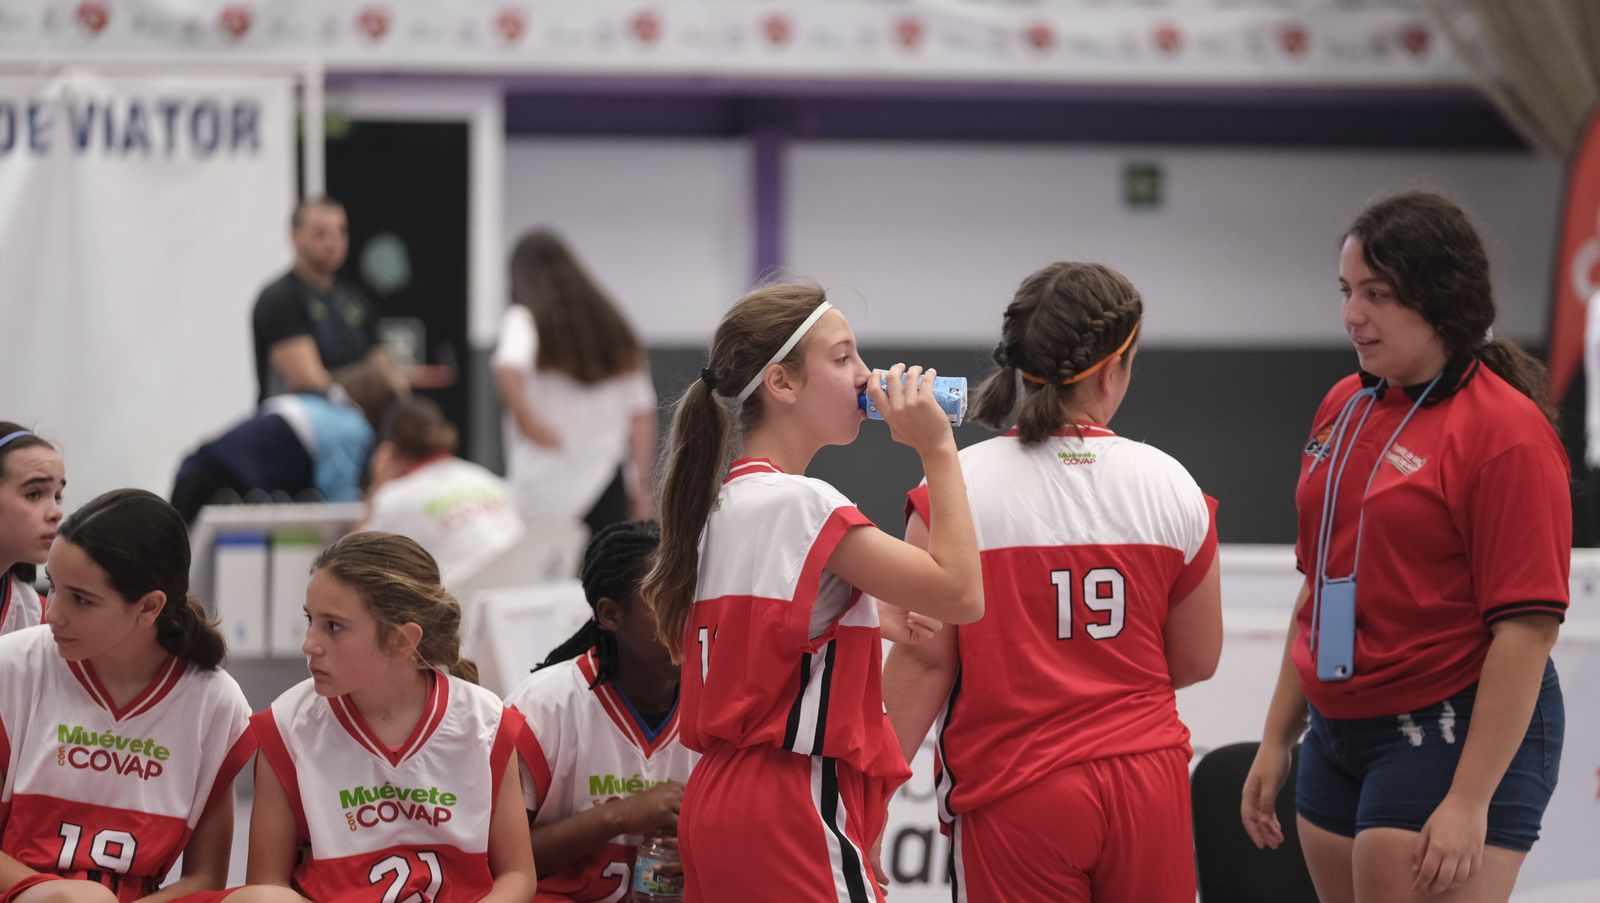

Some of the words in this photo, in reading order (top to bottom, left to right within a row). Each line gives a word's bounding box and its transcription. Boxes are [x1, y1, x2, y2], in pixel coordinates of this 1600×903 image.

[68, 98, 262, 156] VIATOR
[1063, 457, 1096, 466] COVAP
[1050, 567, 1126, 640] 19
[698, 624, 719, 688] 1
[57, 724, 170, 761] Muévete
[68, 746, 163, 780] COVAP
[339, 781, 457, 809] Muévete
[356, 801, 452, 827] COVAP
[56, 821, 137, 874] 19
[368, 850, 443, 903] 21
